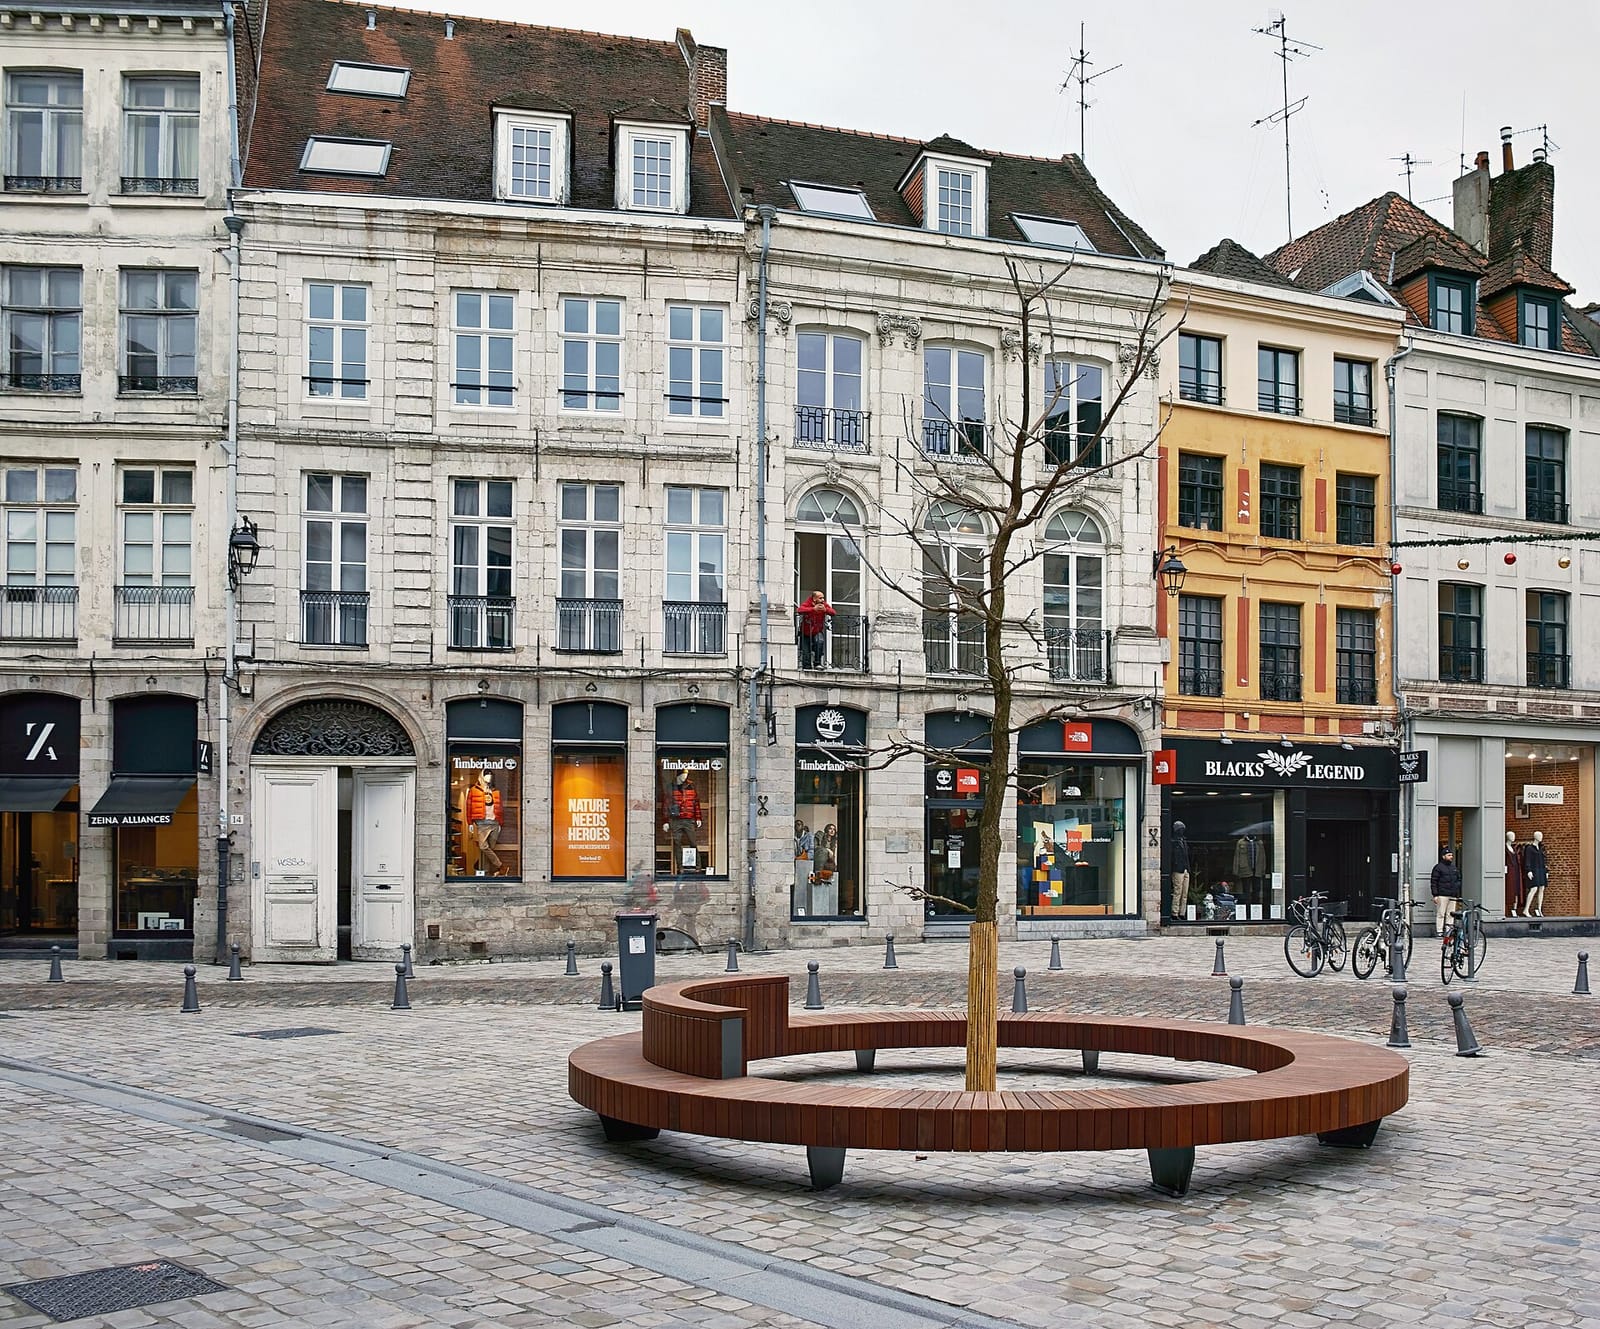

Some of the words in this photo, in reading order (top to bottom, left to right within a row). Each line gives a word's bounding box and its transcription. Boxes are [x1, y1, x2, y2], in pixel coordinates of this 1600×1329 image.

[452, 757, 504, 769] Timberland
[661, 758, 710, 770] Timberland
[1205, 760, 1265, 778] BLACKS
[1306, 764, 1365, 781] LEGEND
[568, 798, 610, 813] NATURE
[91, 816, 118, 825] ZEINA
[122, 815, 171, 824] ALLIANCES
[233, 815, 242, 824] 14
[572, 812, 607, 827] NEEDS
[568, 826, 610, 841] HEROES
